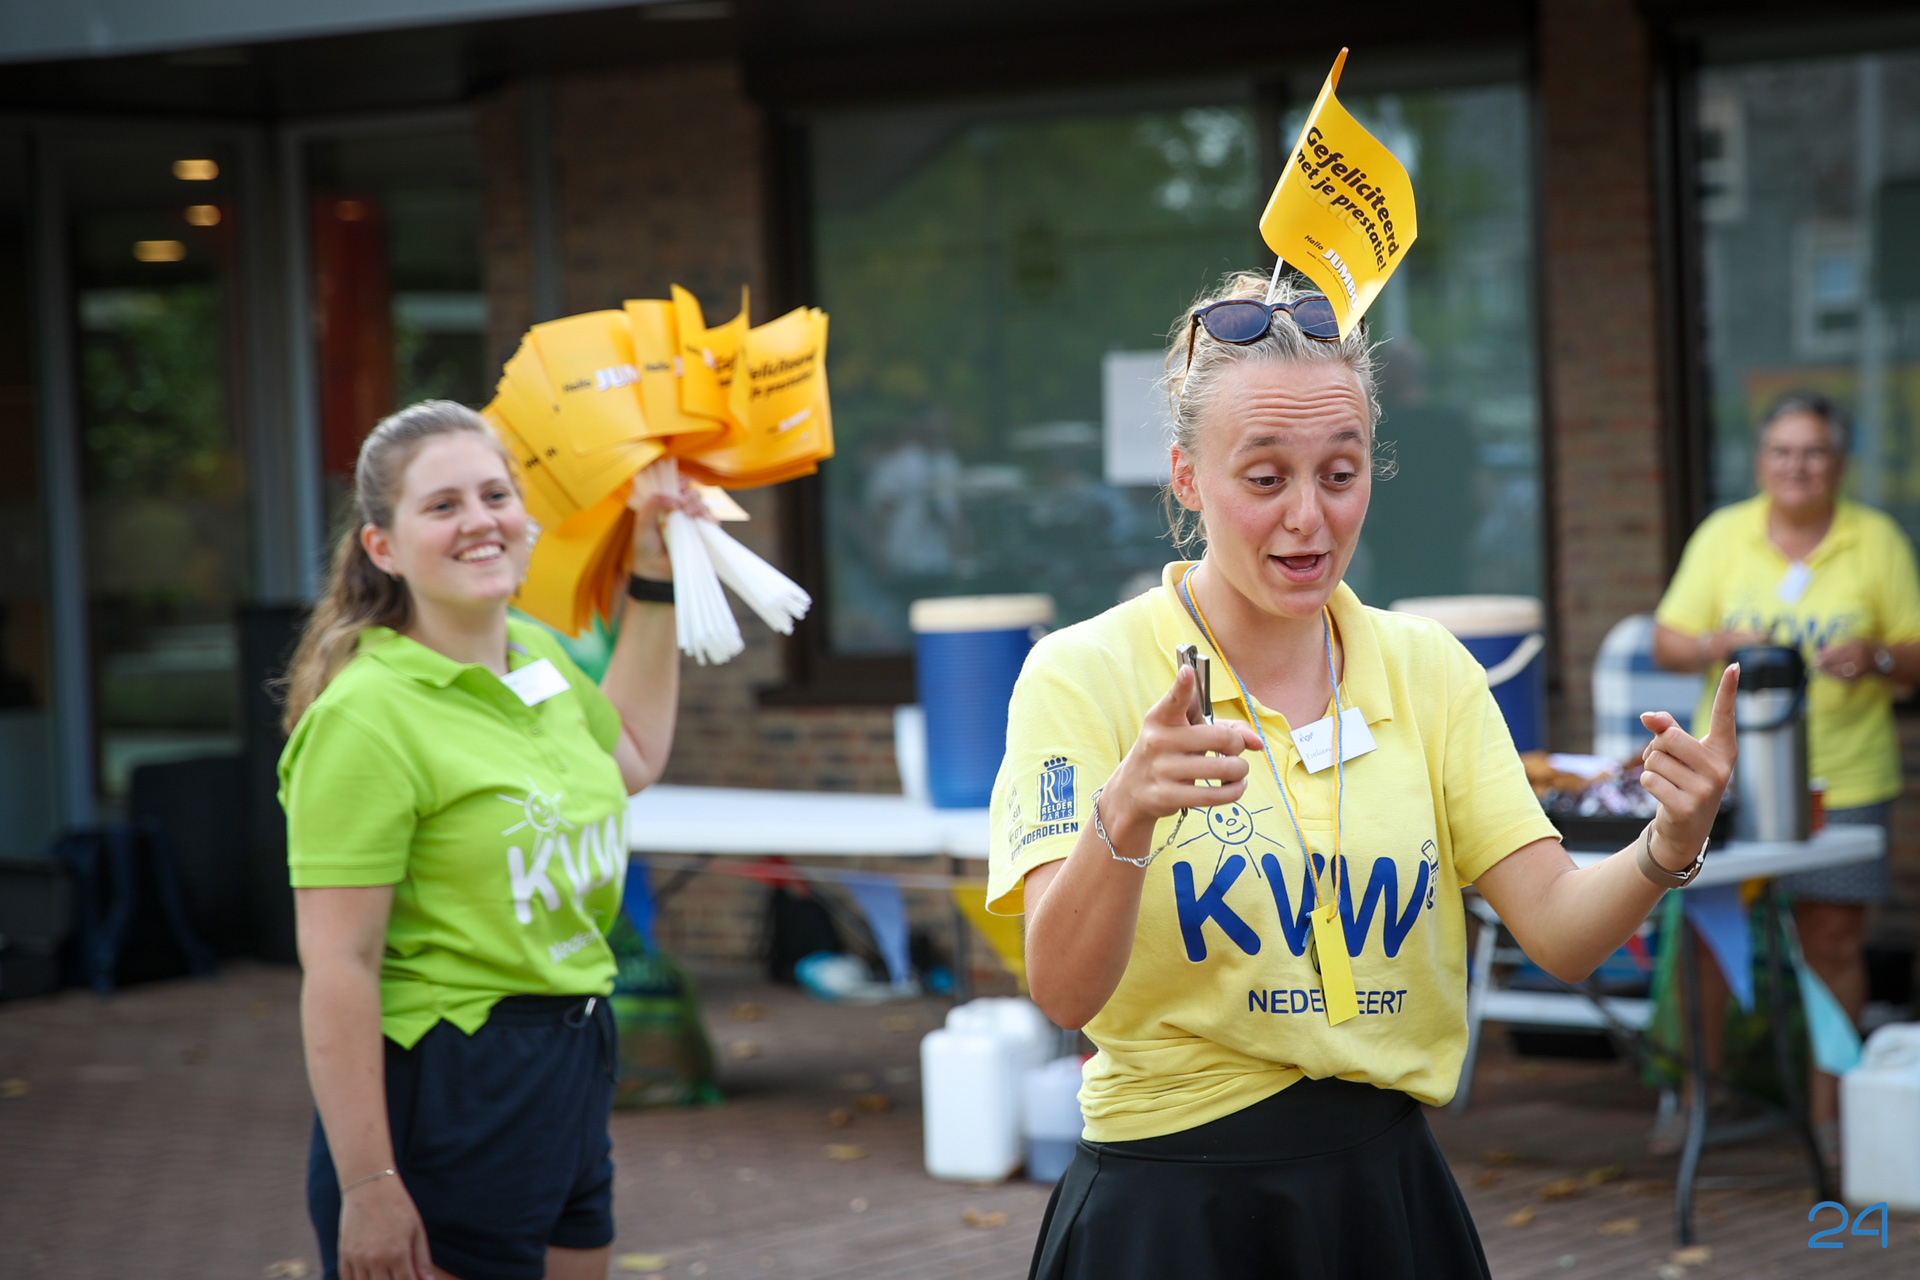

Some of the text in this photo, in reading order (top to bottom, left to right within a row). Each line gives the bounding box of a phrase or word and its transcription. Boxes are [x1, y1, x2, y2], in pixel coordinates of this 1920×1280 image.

[1306, 126, 1400, 258] Gefeliciteerd
[1310, 176, 1336, 196] je
[1330, 194, 1387, 272] prestatie!
[1304, 235, 1324, 250] Hallo
[1321, 248, 1359, 310] JUMBO
[1041, 808, 1074, 822] PARTS
[1042, 801, 1073, 815] RELDER
[1043, 768, 1072, 806] RP
[507, 810, 629, 925] KVW
[1172, 853, 1430, 963] KVW
[1249, 989, 1408, 1015] NEDEEERT
